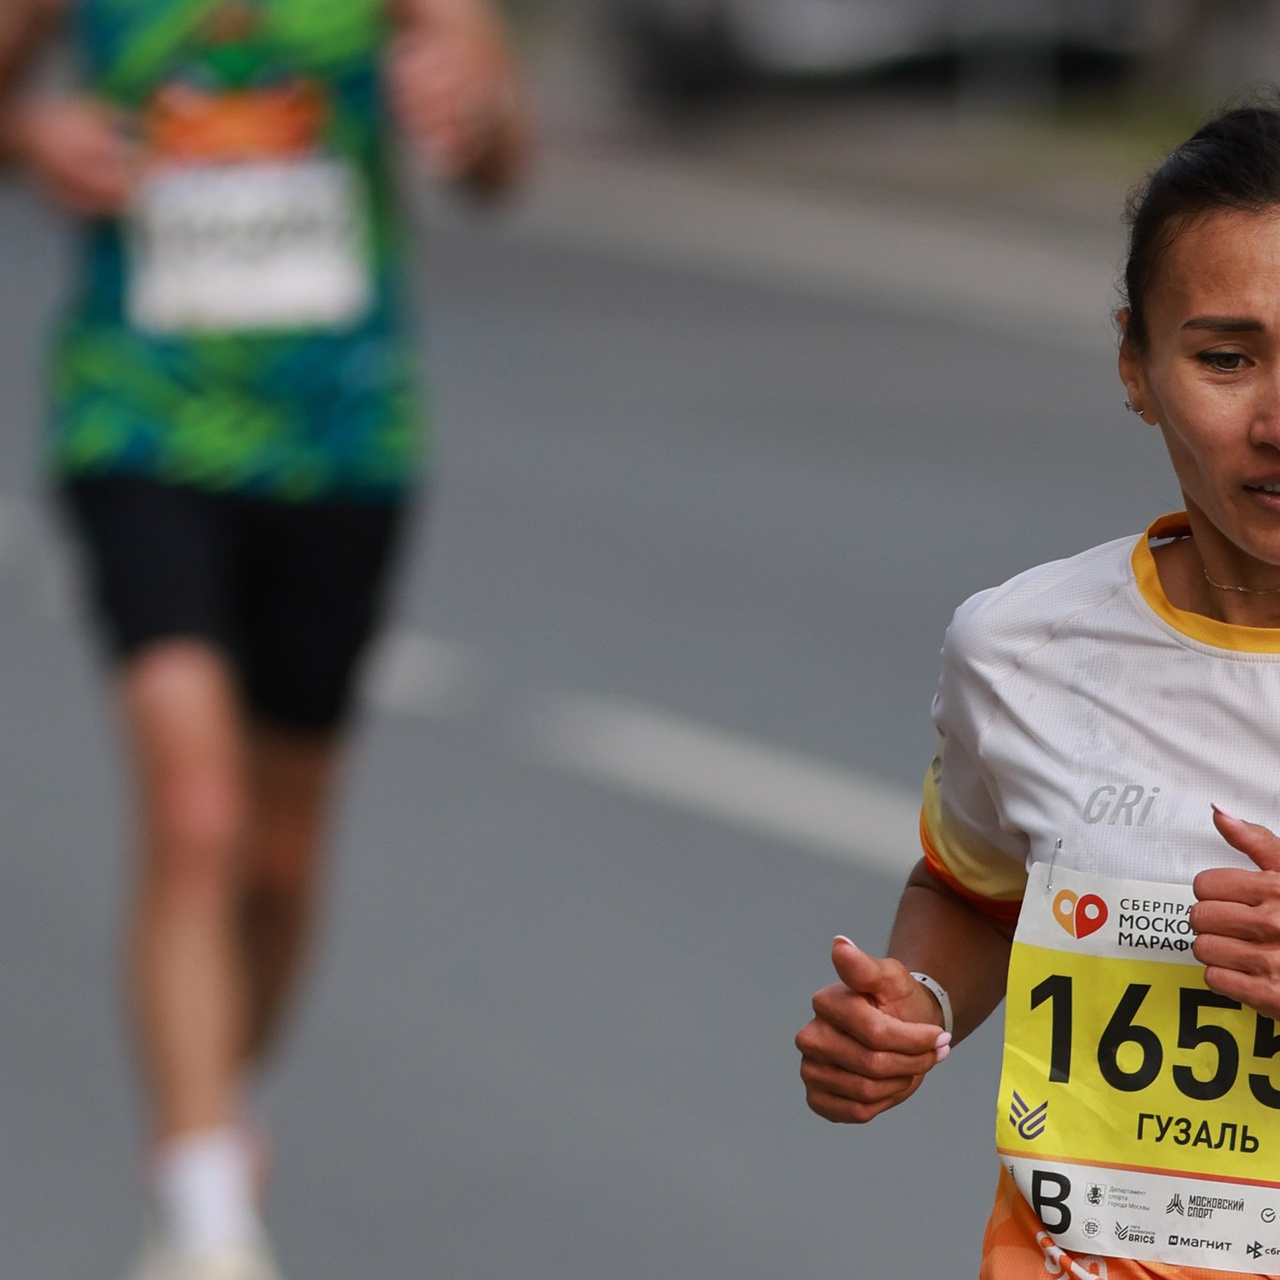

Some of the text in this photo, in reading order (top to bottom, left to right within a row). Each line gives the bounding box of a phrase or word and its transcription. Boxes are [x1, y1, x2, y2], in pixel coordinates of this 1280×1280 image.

[1118, 913, 1200, 935] МОСКО
[1117, 931, 1197, 953] МАРАФ
[1136, 1112, 1260, 1154] ГУЗАЛЬ
[1032, 1169, 1072, 1235] B
[1187, 1206, 1214, 1219] СПОРТ
[1188, 1195, 1245, 1212] МОСКОВСКИЙ
[1128, 1233, 1155, 1244] BRICS
